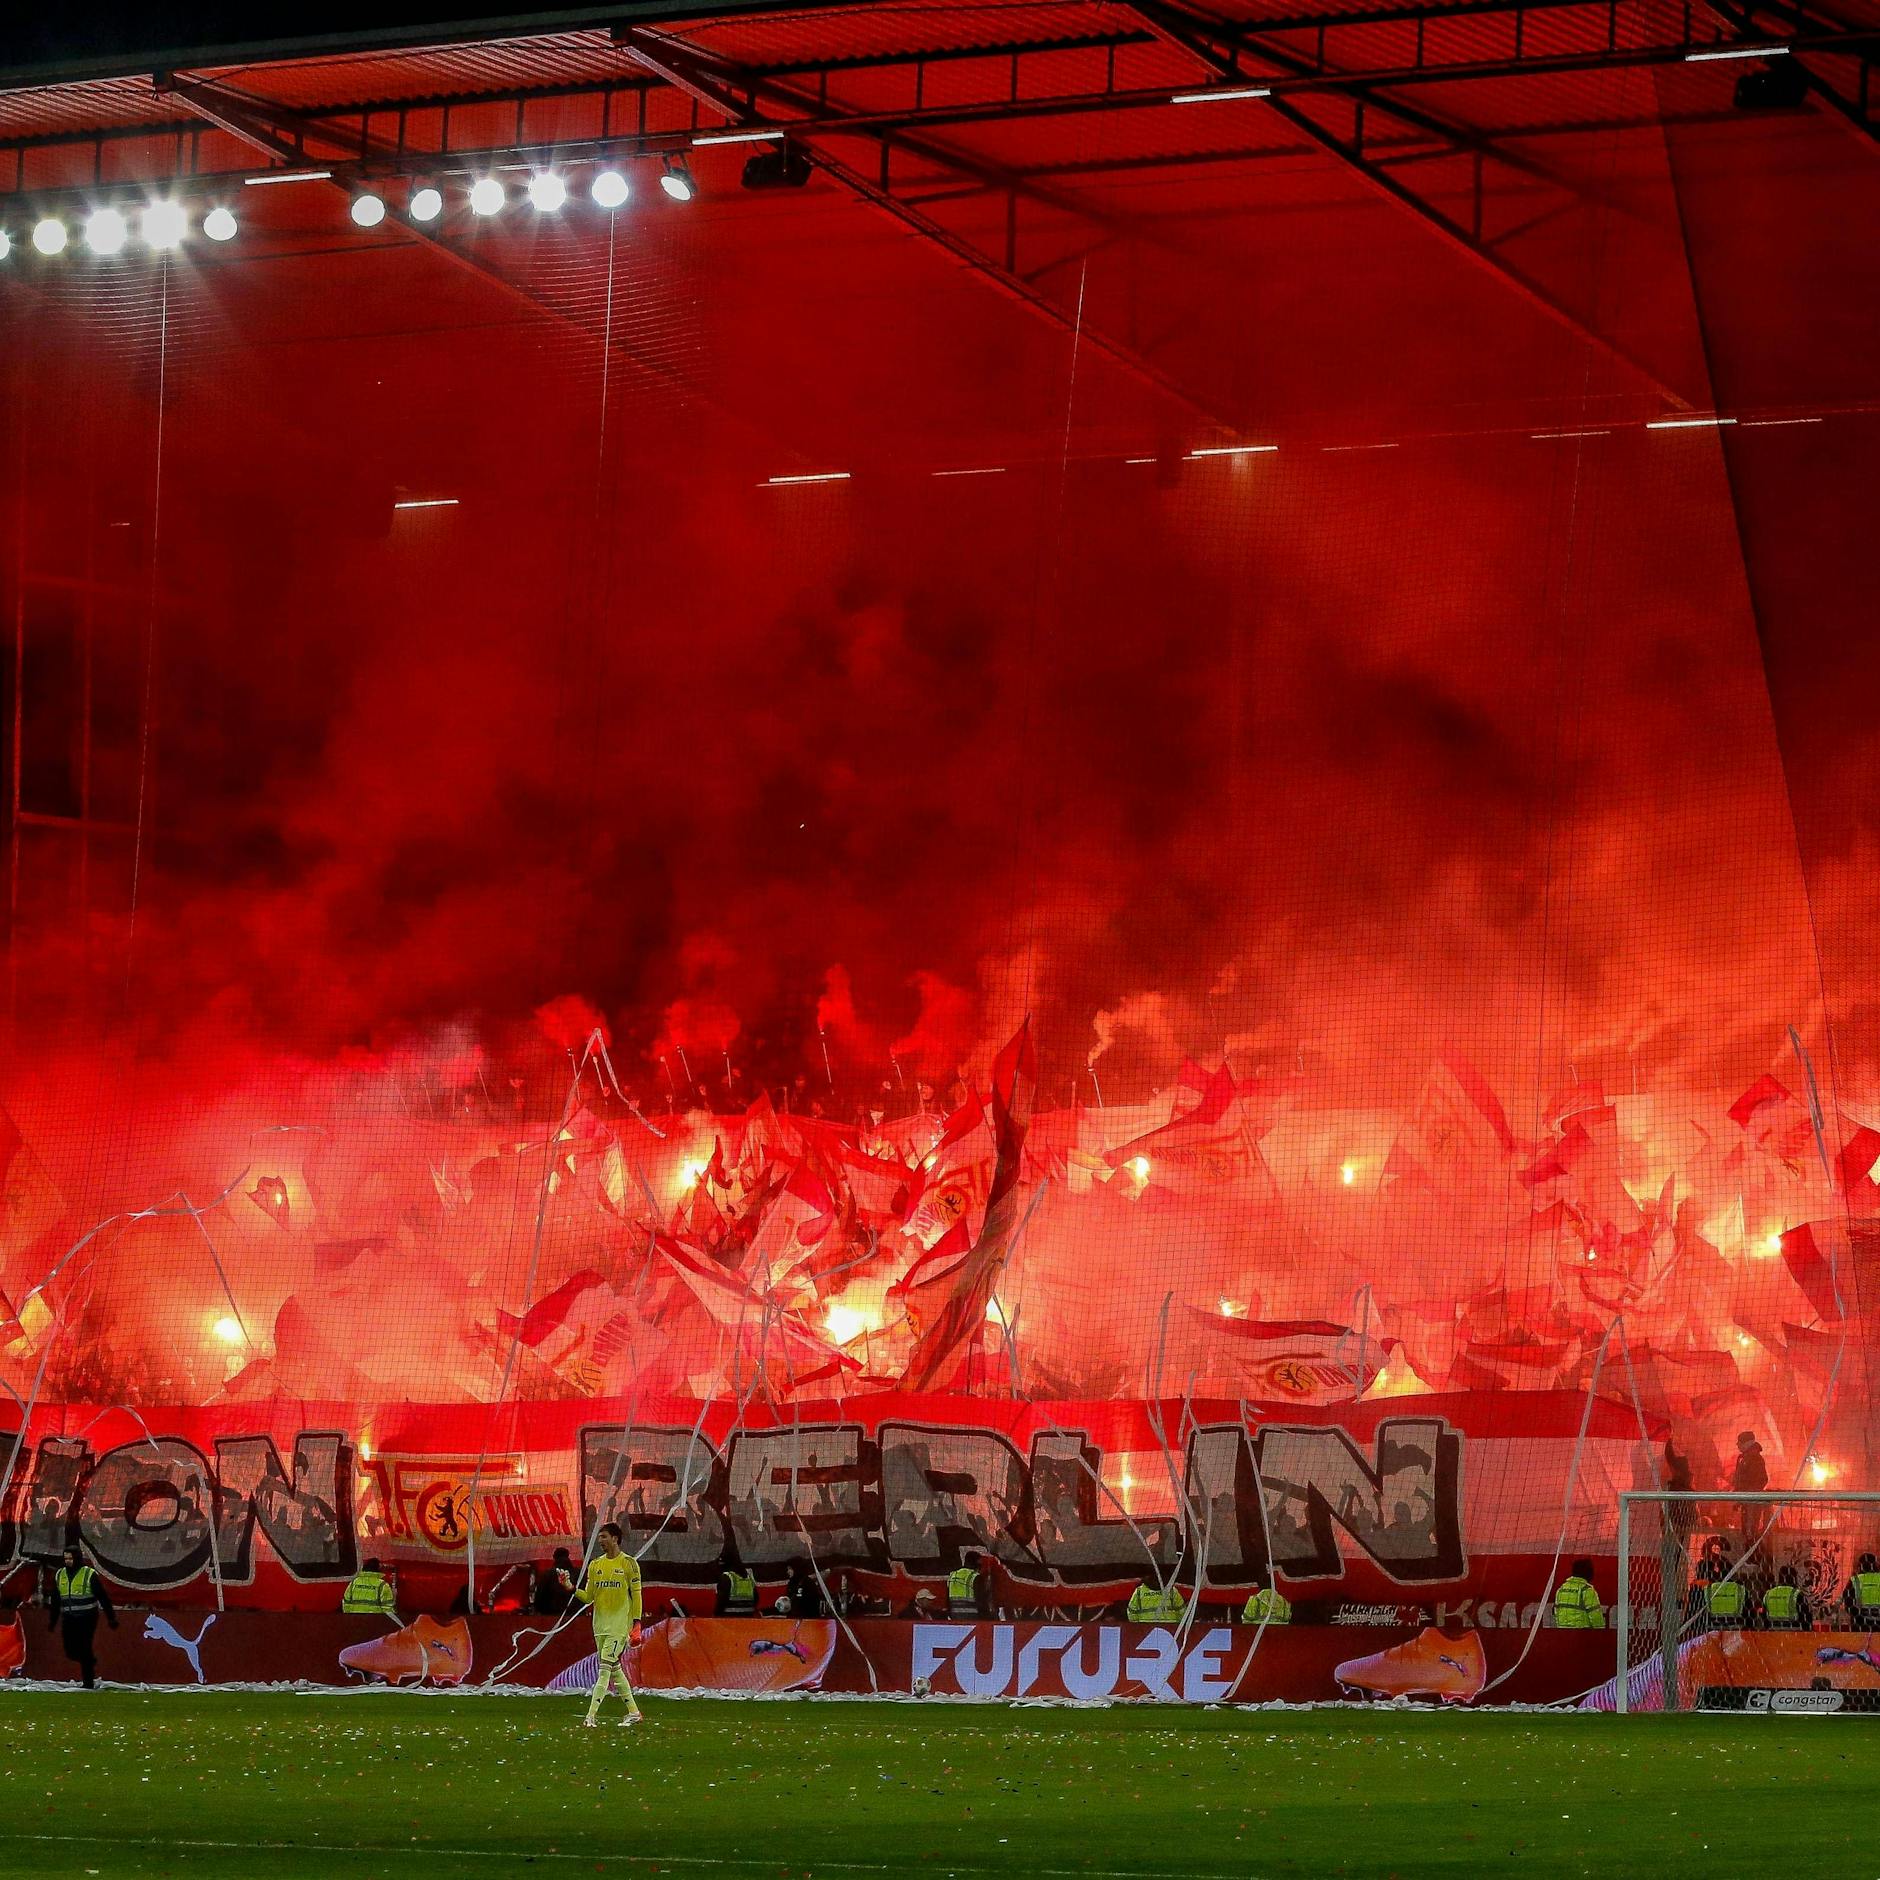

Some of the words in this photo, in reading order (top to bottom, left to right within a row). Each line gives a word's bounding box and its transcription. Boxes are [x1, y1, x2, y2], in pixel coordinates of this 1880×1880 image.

[0, 1429, 361, 1590] ION
[579, 1419, 1468, 1587] BERLIN
[483, 1493, 572, 1539] UNION
[912, 1623, 1234, 1700] FUTURE
[1778, 1694, 1837, 1707] congstar
